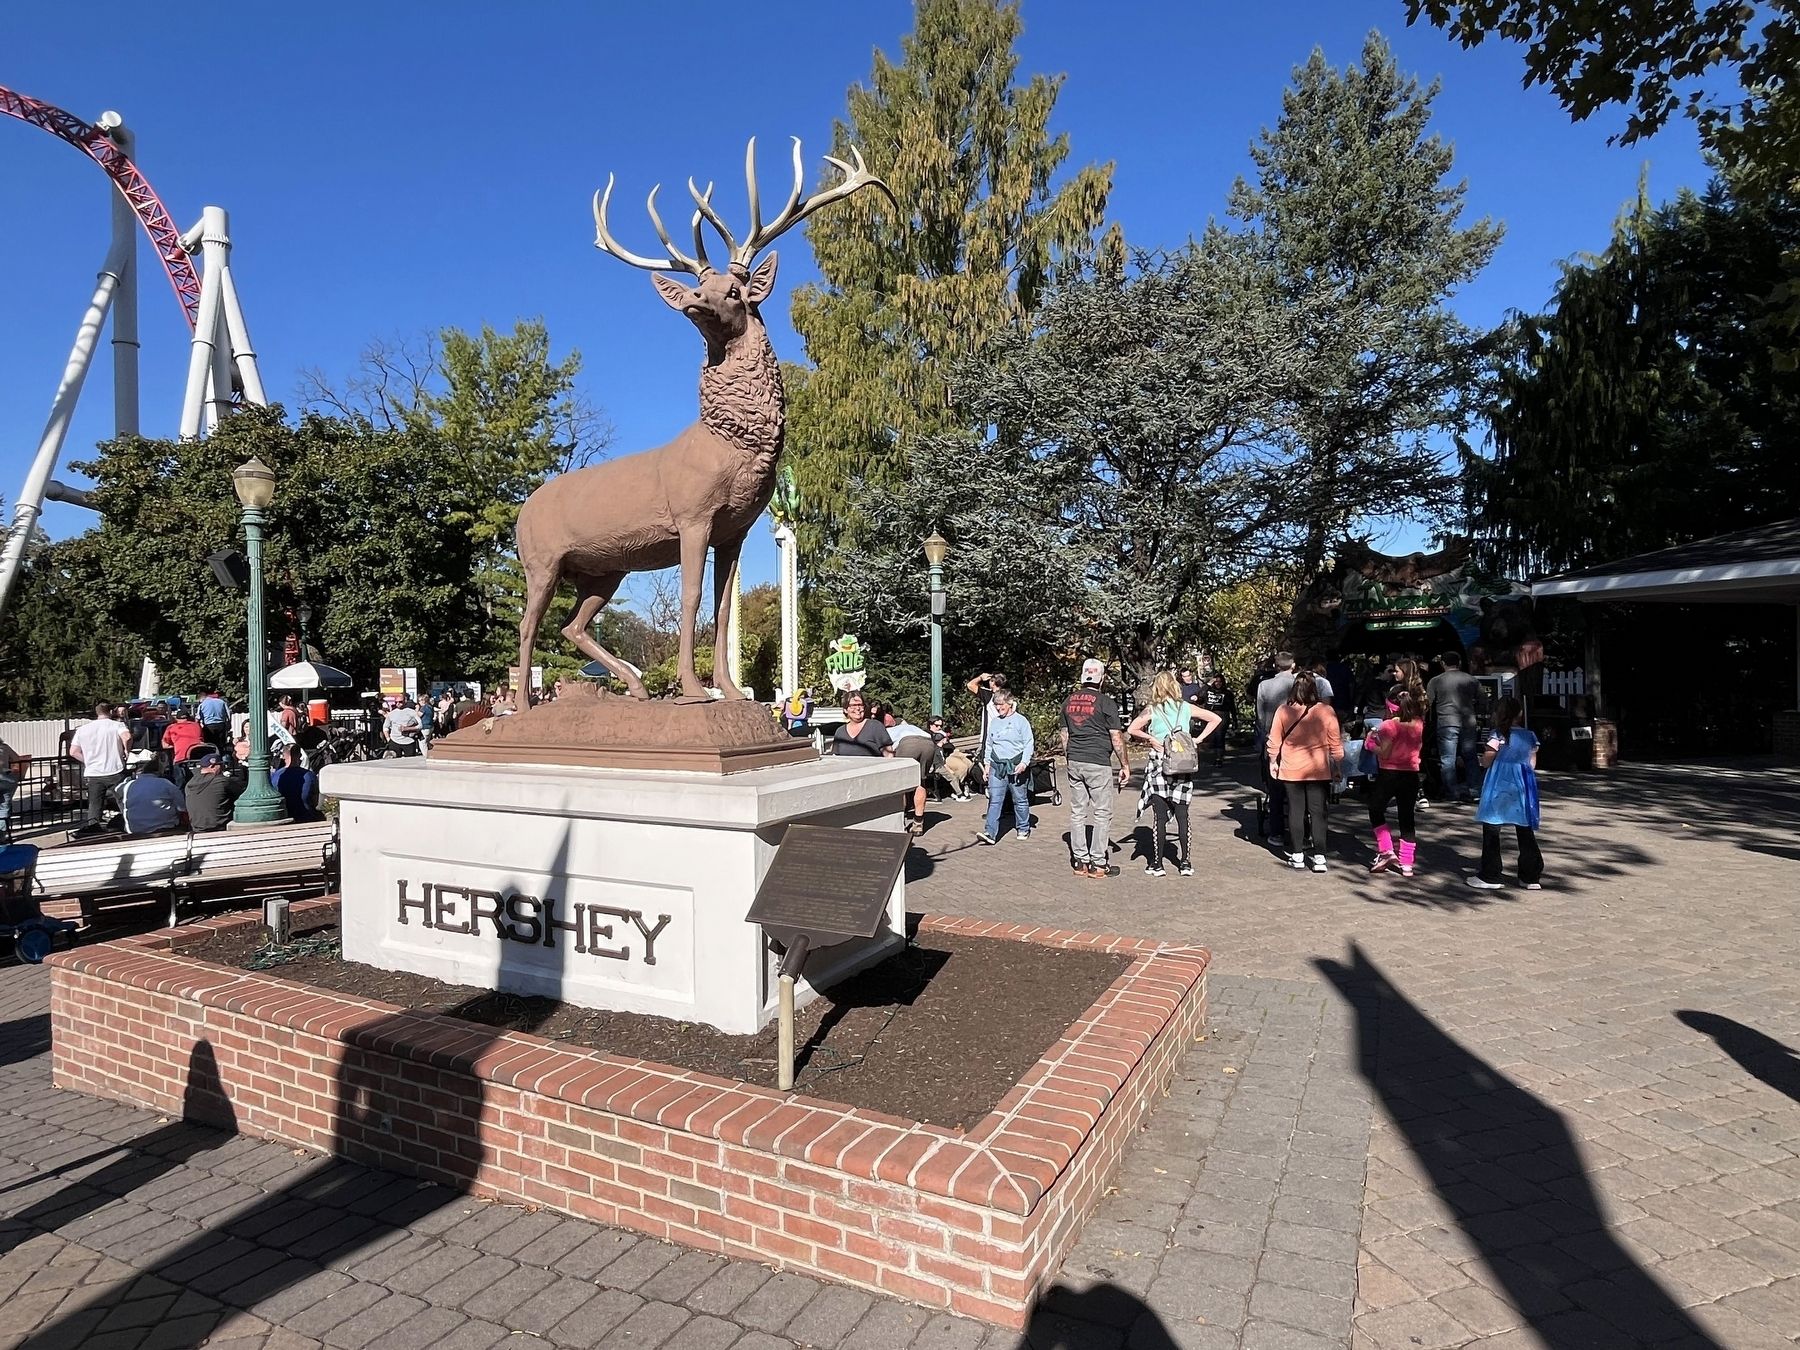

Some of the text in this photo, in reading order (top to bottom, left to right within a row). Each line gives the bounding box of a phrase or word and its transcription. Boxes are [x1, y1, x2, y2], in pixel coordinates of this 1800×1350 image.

[1373, 620, 1432, 629] ENTRANCE
[825, 651, 865, 674] FROG
[397, 879, 672, 966] HERSHEY
